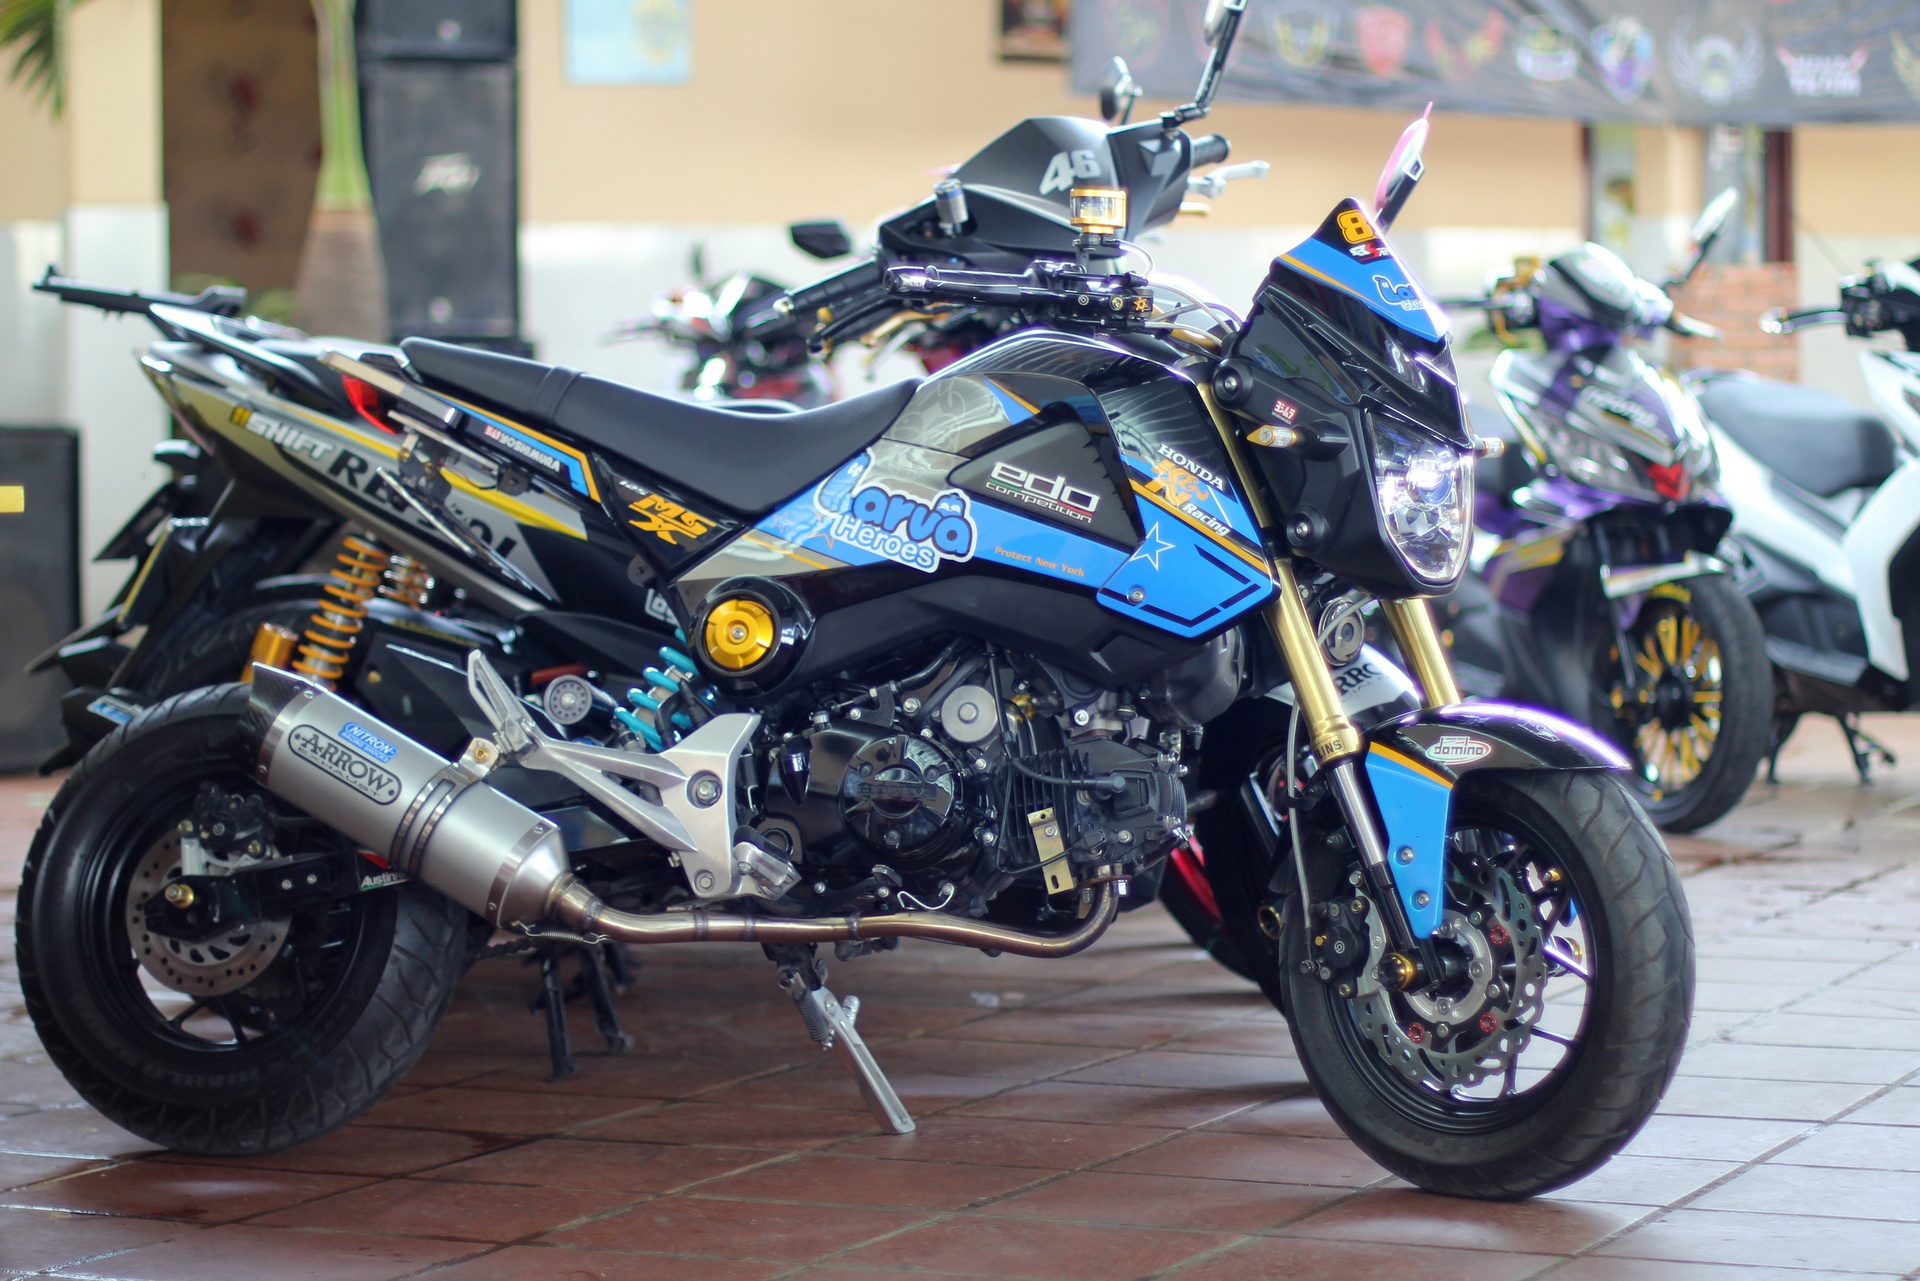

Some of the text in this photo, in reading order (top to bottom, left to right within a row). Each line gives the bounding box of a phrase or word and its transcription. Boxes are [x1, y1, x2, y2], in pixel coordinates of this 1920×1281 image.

[1039, 150, 1100, 195] 46
[245, 410, 334, 461] SHIFT
[499, 432, 561, 472] YOSHIMURA
[991, 461, 1101, 512] edo
[1158, 443, 1224, 491] HONDA
[985, 482, 1092, 524] competition
[1182, 502, 1231, 536] Racing
[836, 513, 937, 571] Heroes
[995, 546, 1085, 577] Protect New York
[349, 726, 393, 754] NITRON
[1433, 737, 1484, 755] domino
[301, 733, 394, 791] ARROW
